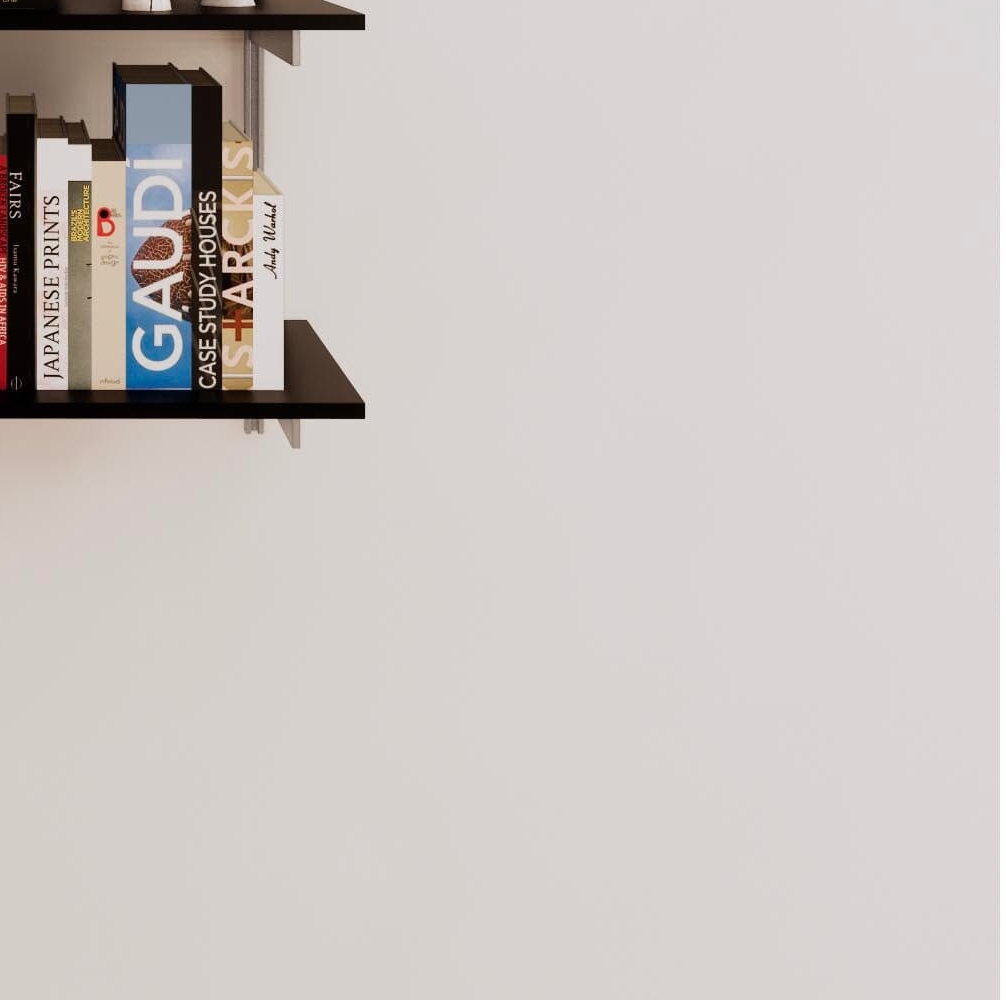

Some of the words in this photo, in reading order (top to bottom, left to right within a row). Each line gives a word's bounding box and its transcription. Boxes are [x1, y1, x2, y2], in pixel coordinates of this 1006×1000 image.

[9, 172, 23, 219] FAIRS
[262, 201, 278, 242] Warhol
[43, 195, 60, 270] PRINTS
[198, 190, 217, 267] HOUSES
[263, 247, 280, 280] Andy
[43, 276, 64, 379] JAPANESE
[198, 272, 217, 334] STUDY
[198, 339, 217, 389] CASE
